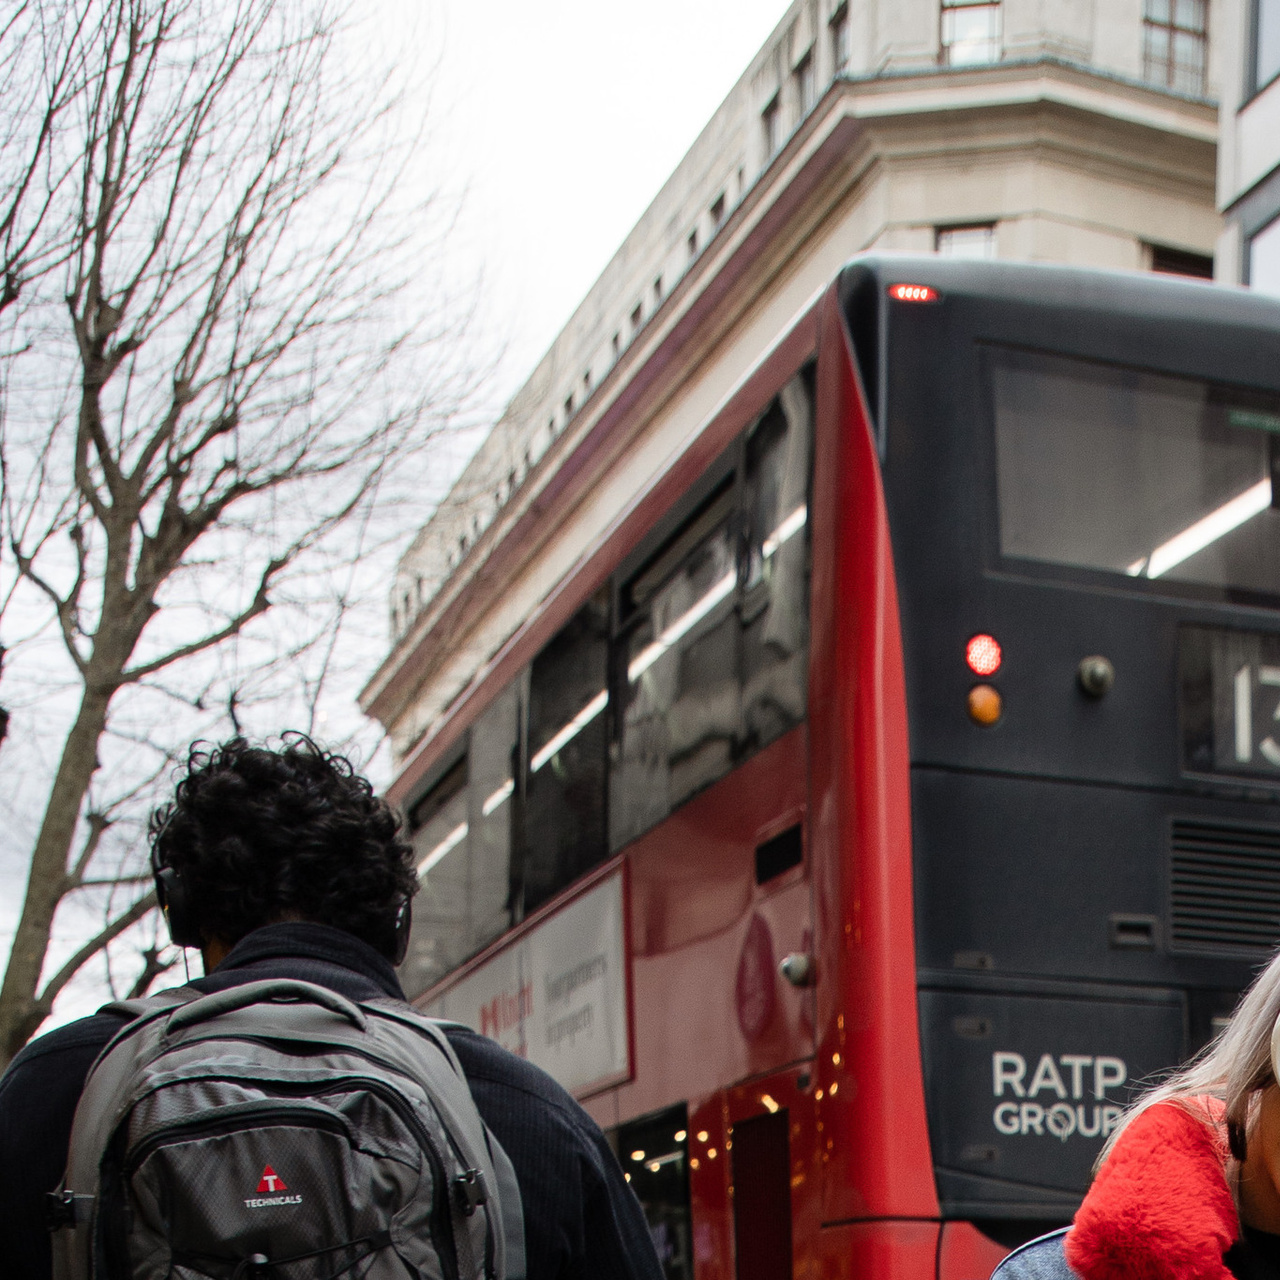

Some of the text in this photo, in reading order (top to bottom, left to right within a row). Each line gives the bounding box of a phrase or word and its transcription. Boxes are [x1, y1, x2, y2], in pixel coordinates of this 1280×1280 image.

[993, 1051, 1127, 1099] RATP
[993, 1102, 1123, 1138] GROUP
[263, 1175, 278, 1192] T
[244, 1194, 303, 1208] TECHNICALS
